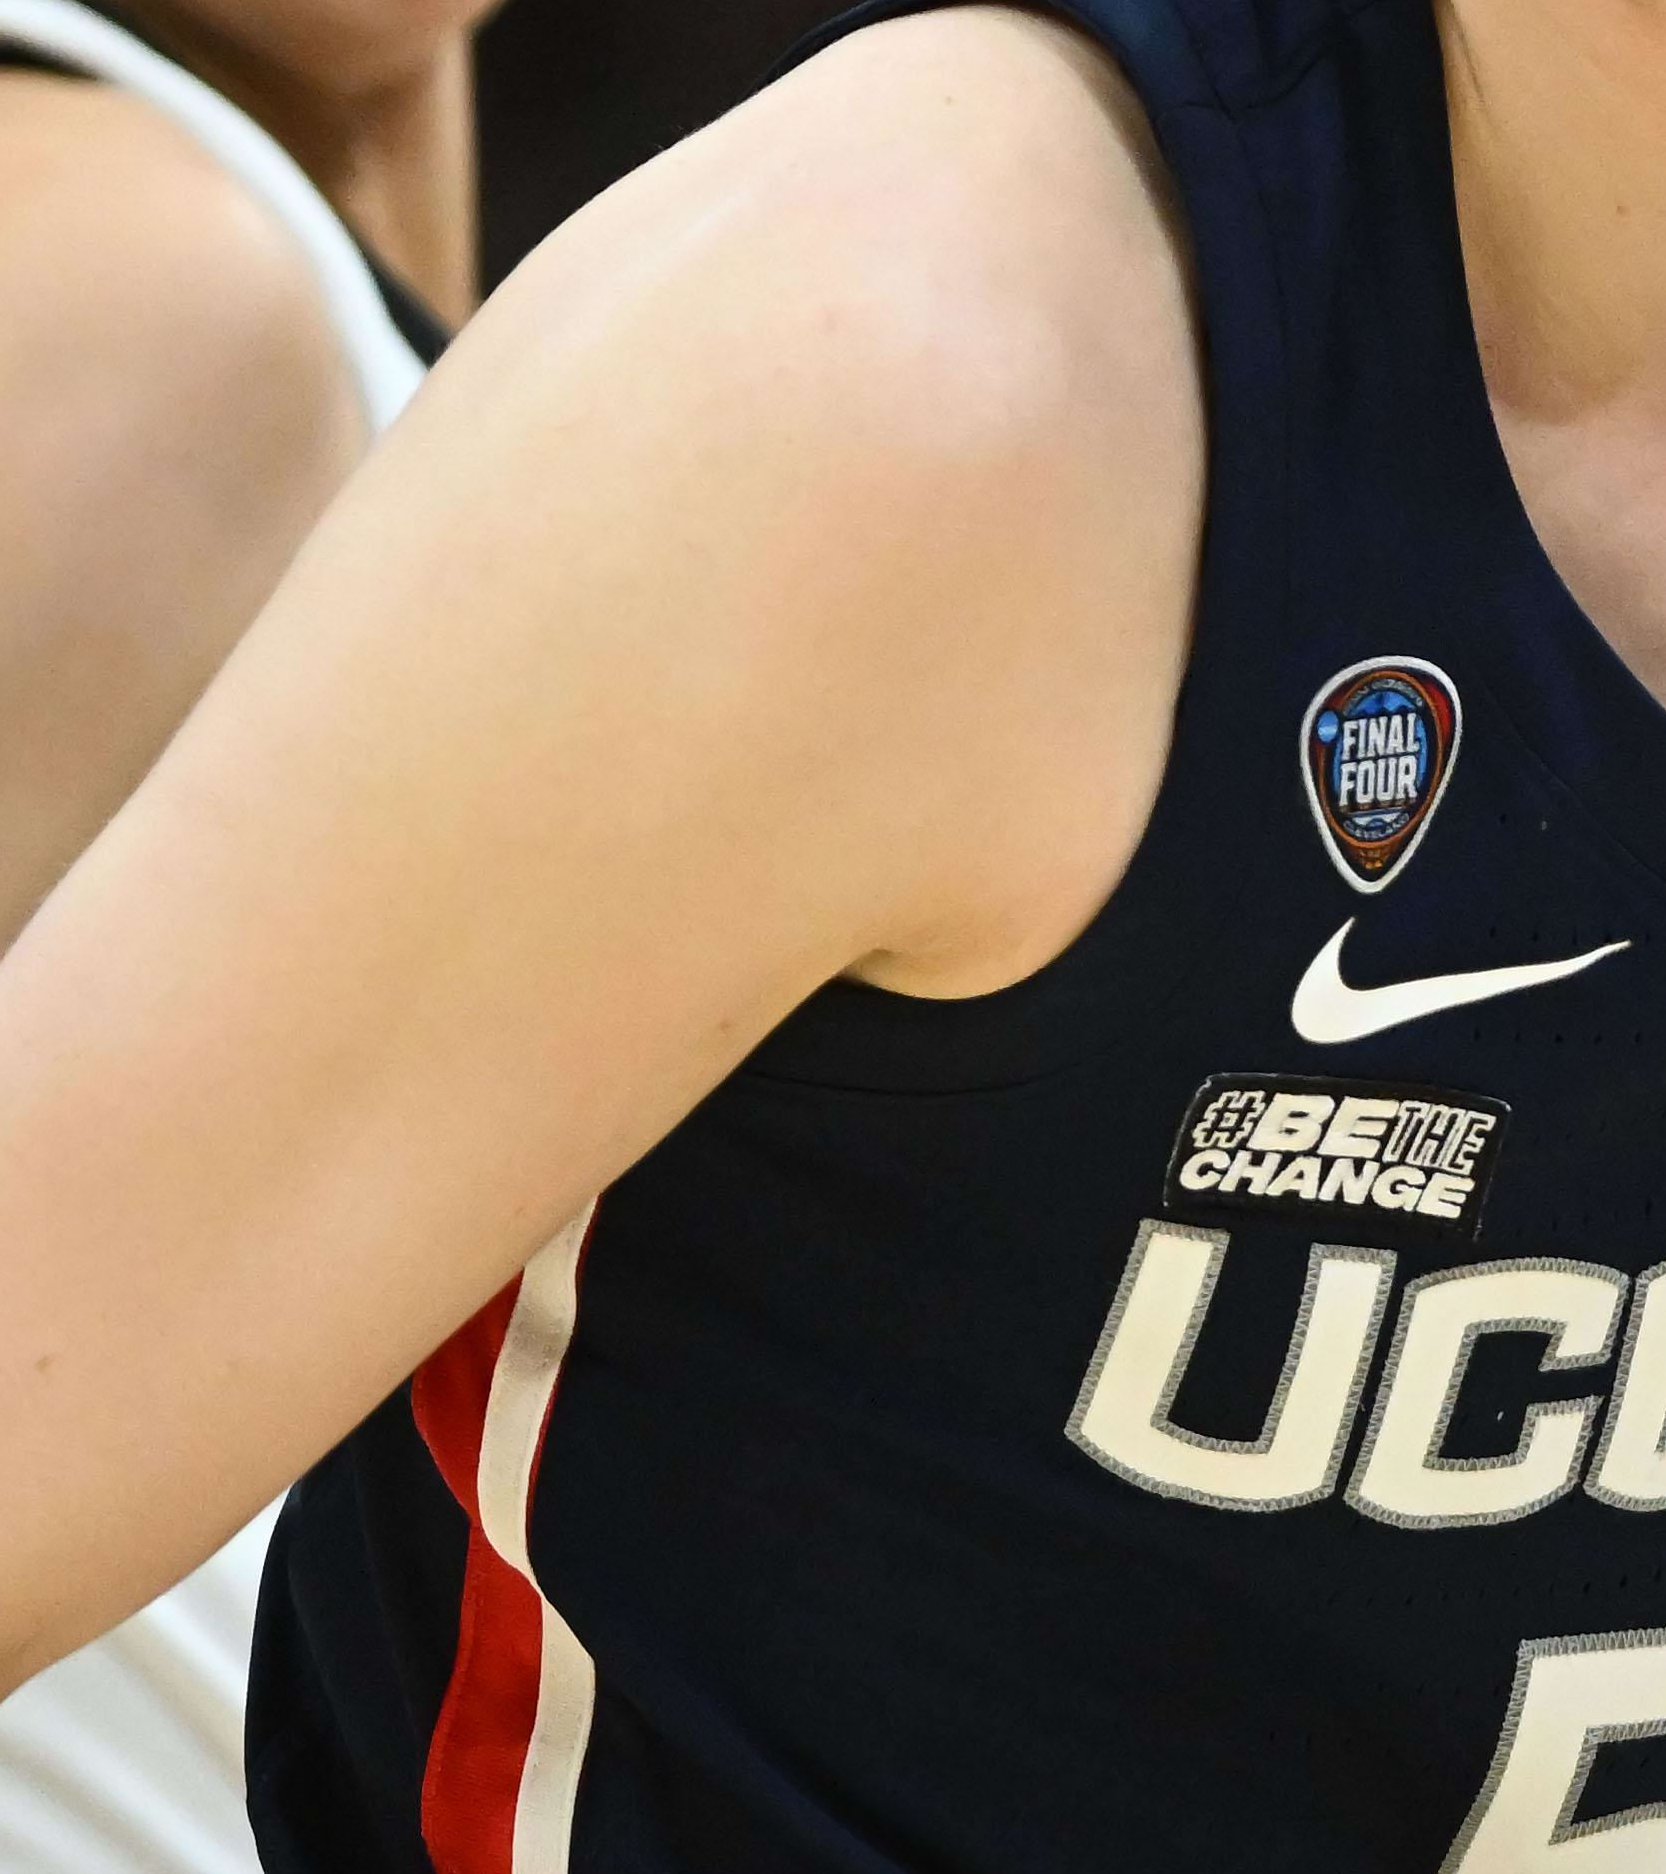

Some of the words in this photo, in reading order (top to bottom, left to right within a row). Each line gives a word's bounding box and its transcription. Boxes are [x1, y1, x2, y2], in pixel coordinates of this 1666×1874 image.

[1341, 713, 1420, 760] FINAL
[1338, 755, 1418, 807] FOUR
[1179, 1149, 1475, 1219] CHANGE
